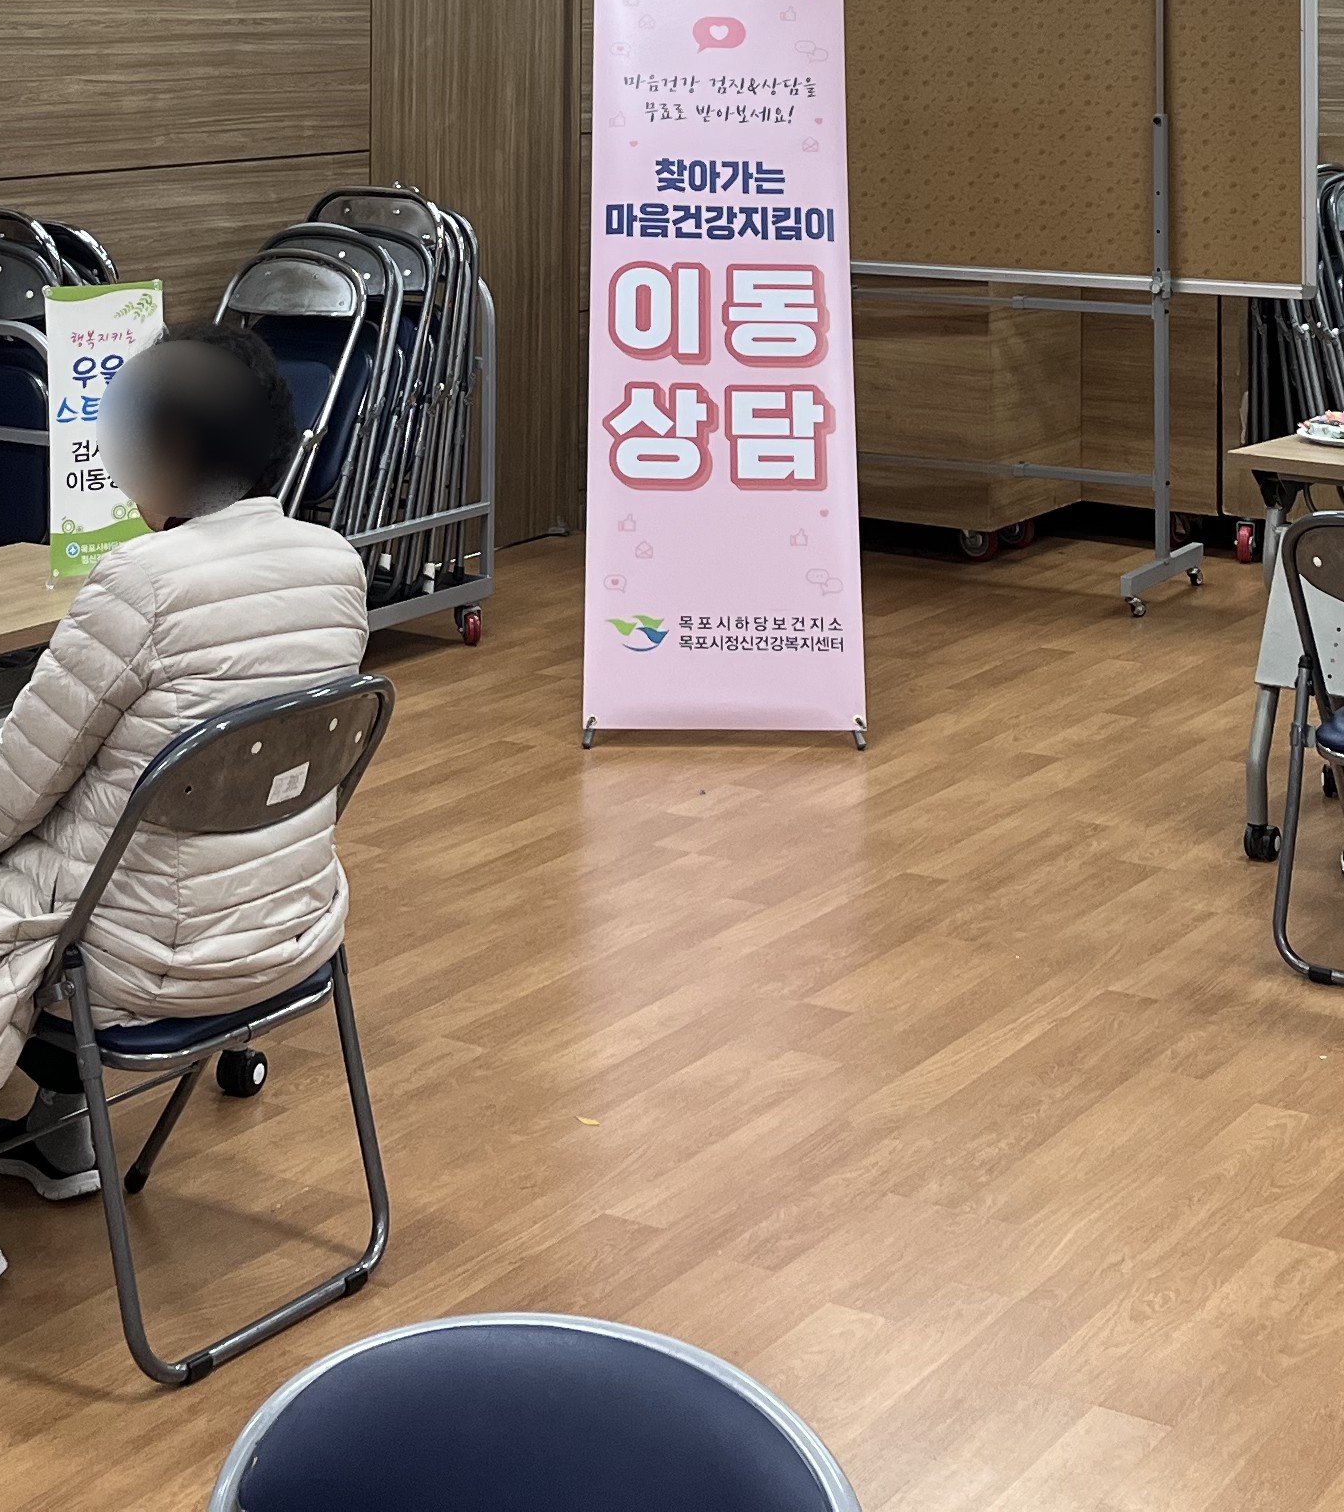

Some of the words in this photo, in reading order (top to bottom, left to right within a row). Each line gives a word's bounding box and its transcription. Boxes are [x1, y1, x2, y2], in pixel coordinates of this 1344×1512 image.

[624, 73, 700, 94] 마음건강
[709, 76, 816, 99] 검진&상담을
[645, 101, 687, 122] 무료로
[696, 104, 795, 124] 받아보세요!
[655, 157, 786, 195] 찾아가는
[605, 202, 835, 242] 마음건강지킴이
[608, 260, 830, 368] 이동
[70, 330, 136, 349] 행복지키는
[603, 381, 836, 491] 상담
[678, 615, 844, 632] 목포시하당보건지소
[678, 635, 844, 652] 목포시정신건강복지센터
